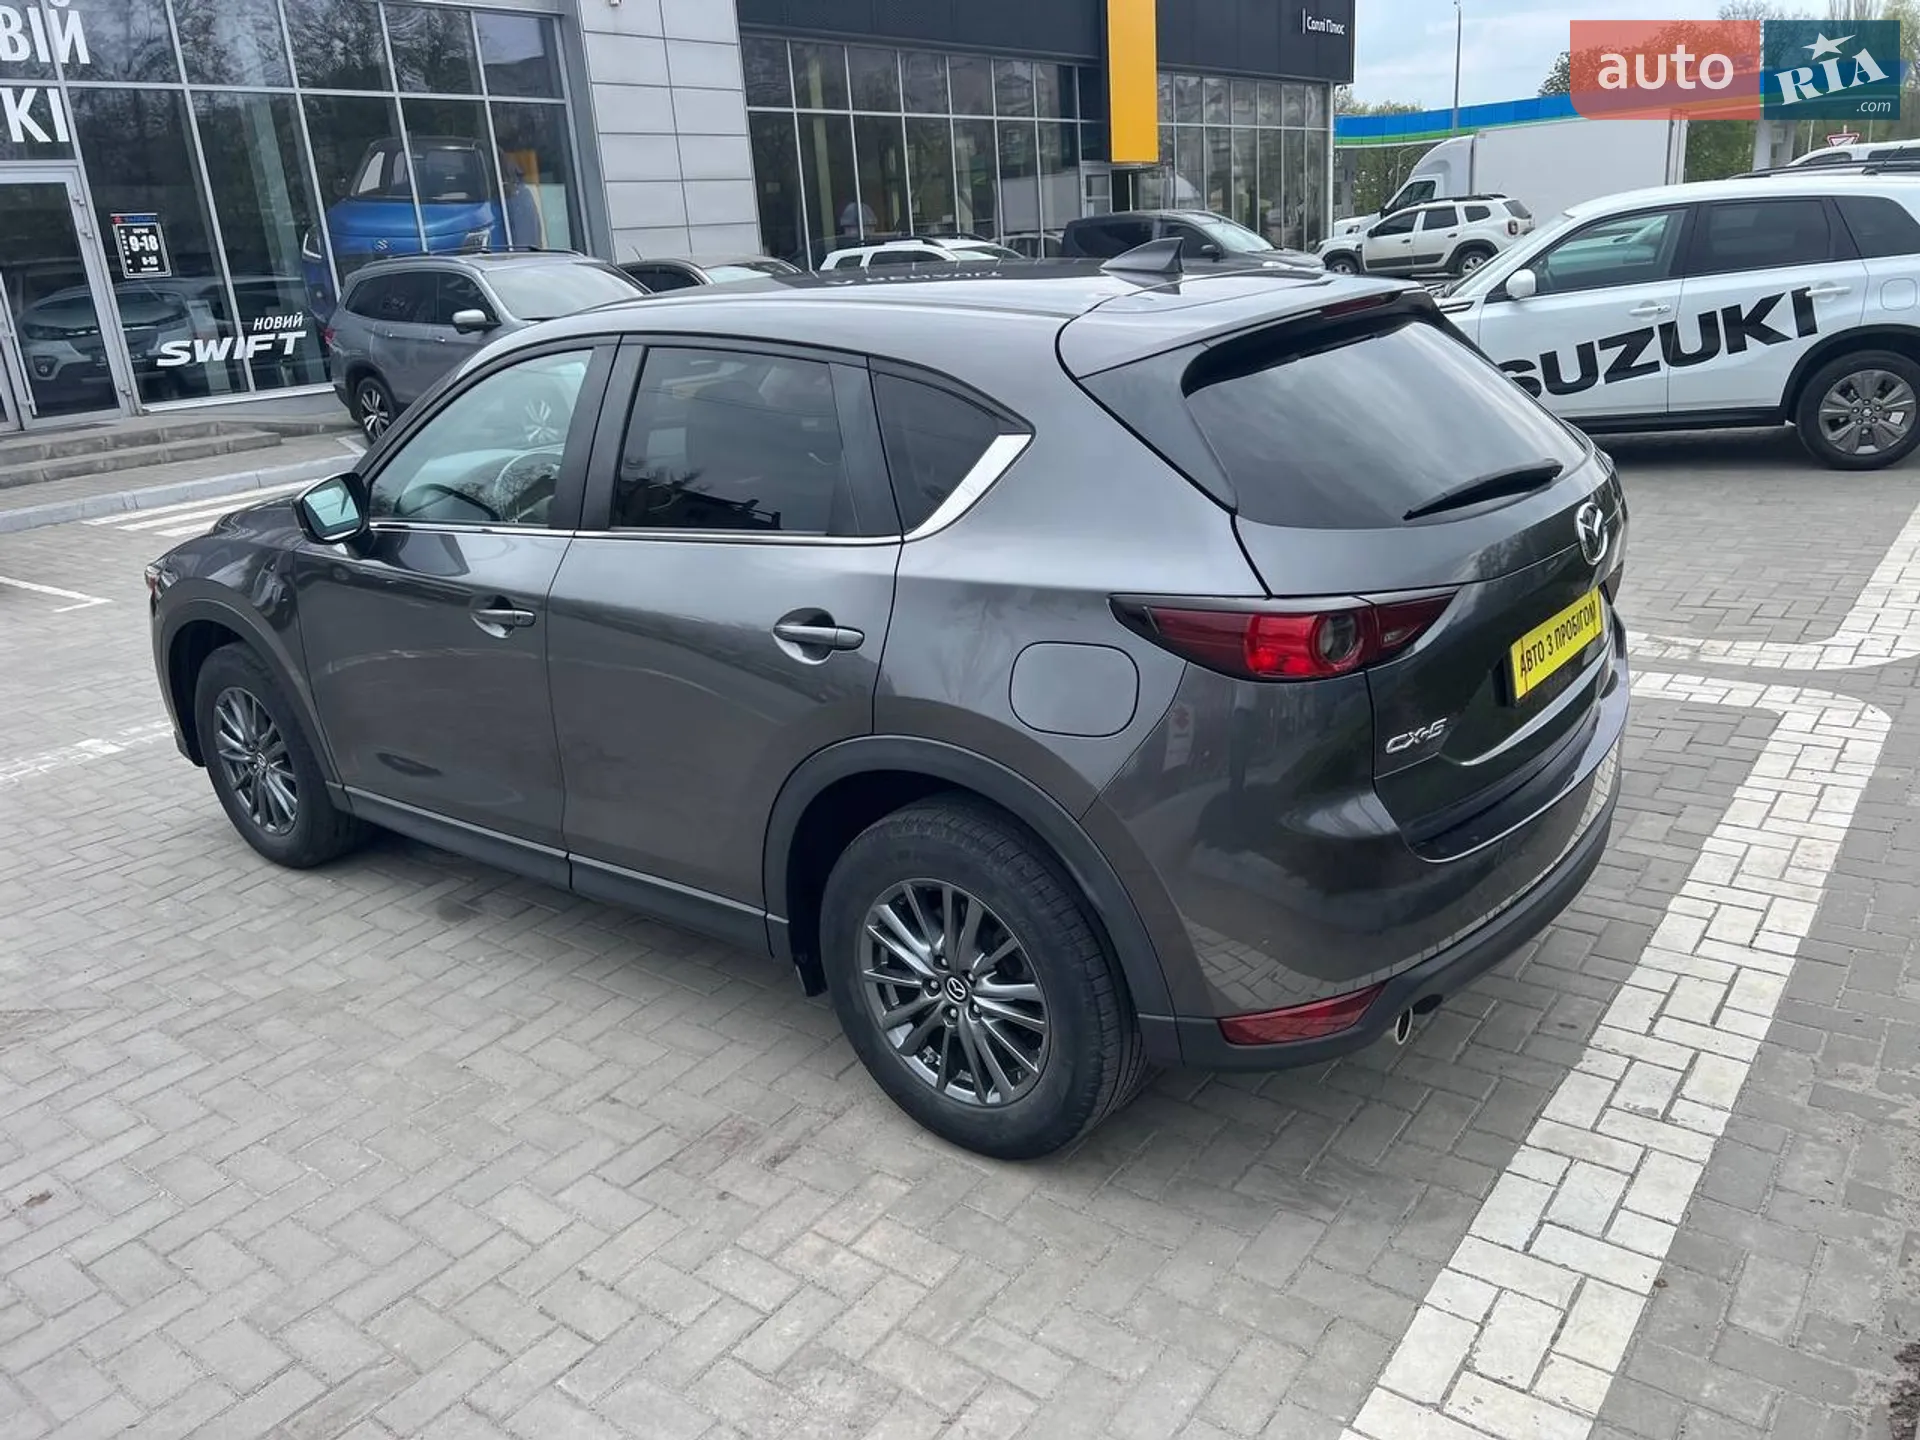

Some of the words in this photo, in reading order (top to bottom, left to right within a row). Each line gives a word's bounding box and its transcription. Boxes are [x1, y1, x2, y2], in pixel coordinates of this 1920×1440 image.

[253, 311, 304, 331] НОВИЙ
[156, 331, 307, 366] SWIFT
[1520, 640, 1545, 678] АВТО
